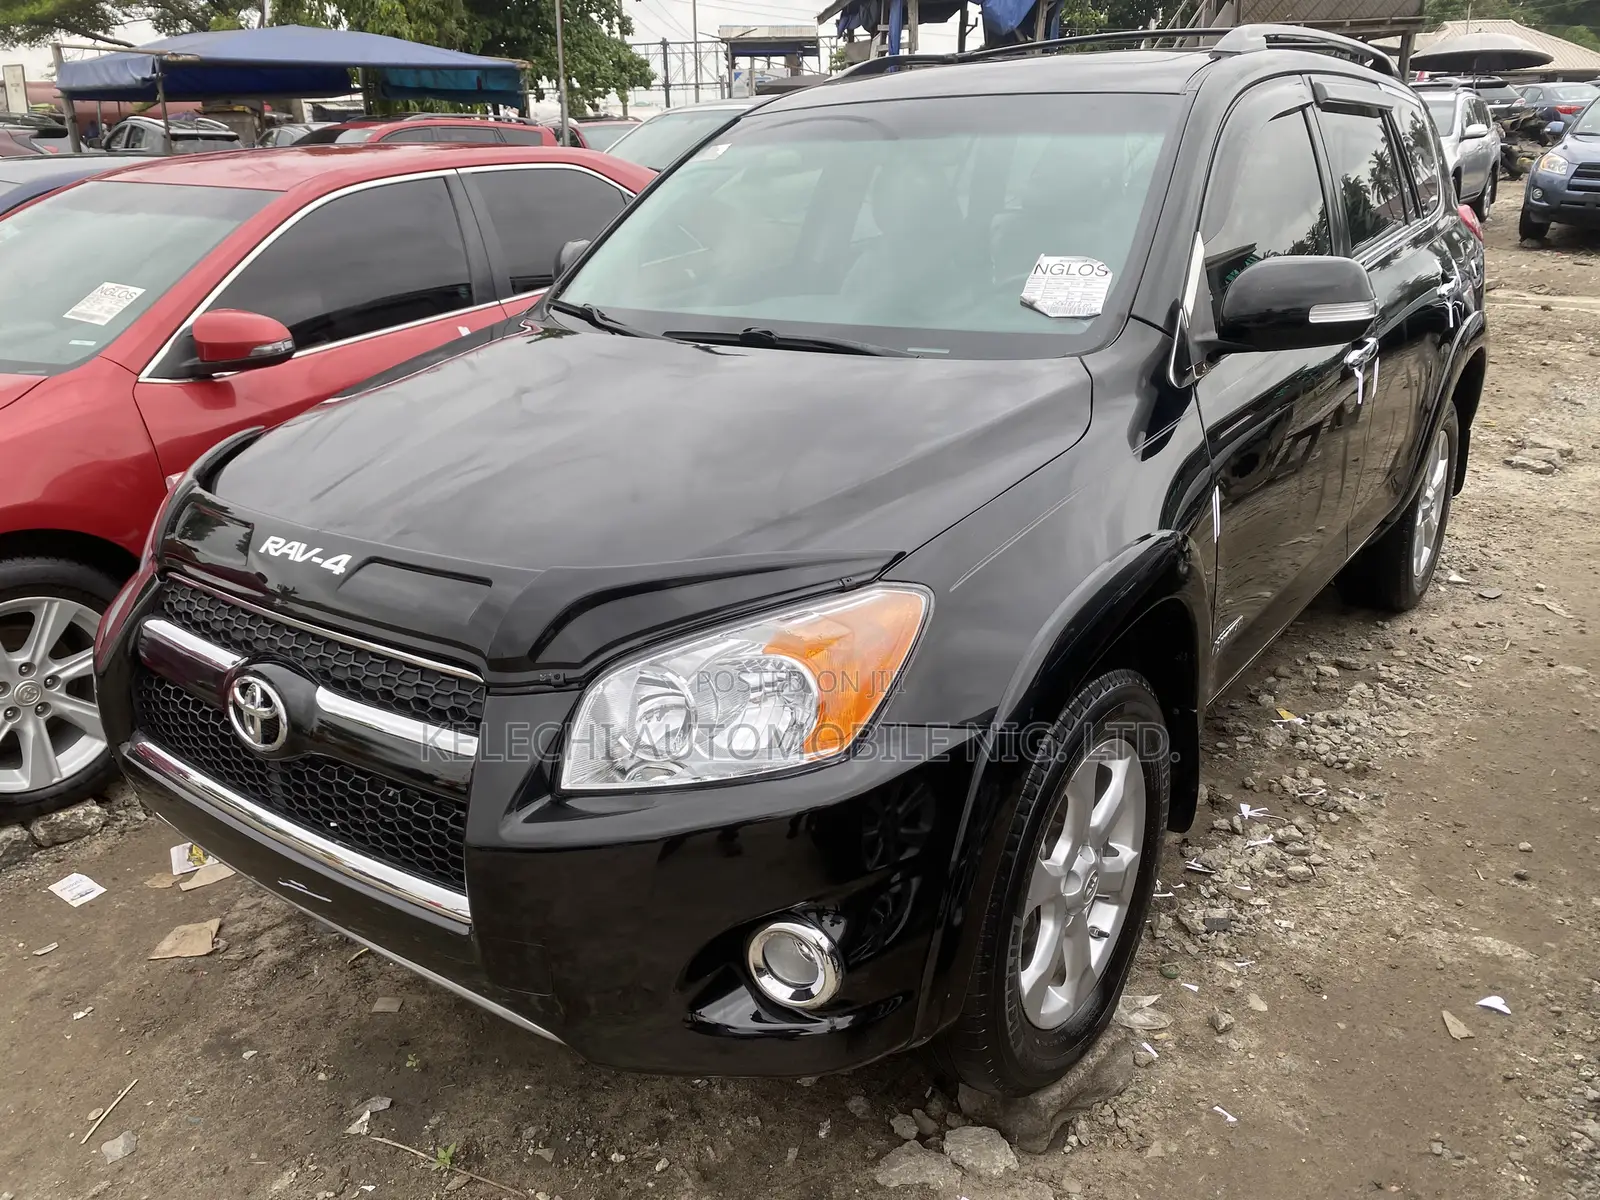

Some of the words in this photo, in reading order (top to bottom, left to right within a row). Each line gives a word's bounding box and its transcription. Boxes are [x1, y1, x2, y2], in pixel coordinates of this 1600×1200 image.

[1033, 263, 1109, 277] NGLOS
[97, 286, 137, 300] NGLOS
[258, 535, 353, 575] RAV-4
